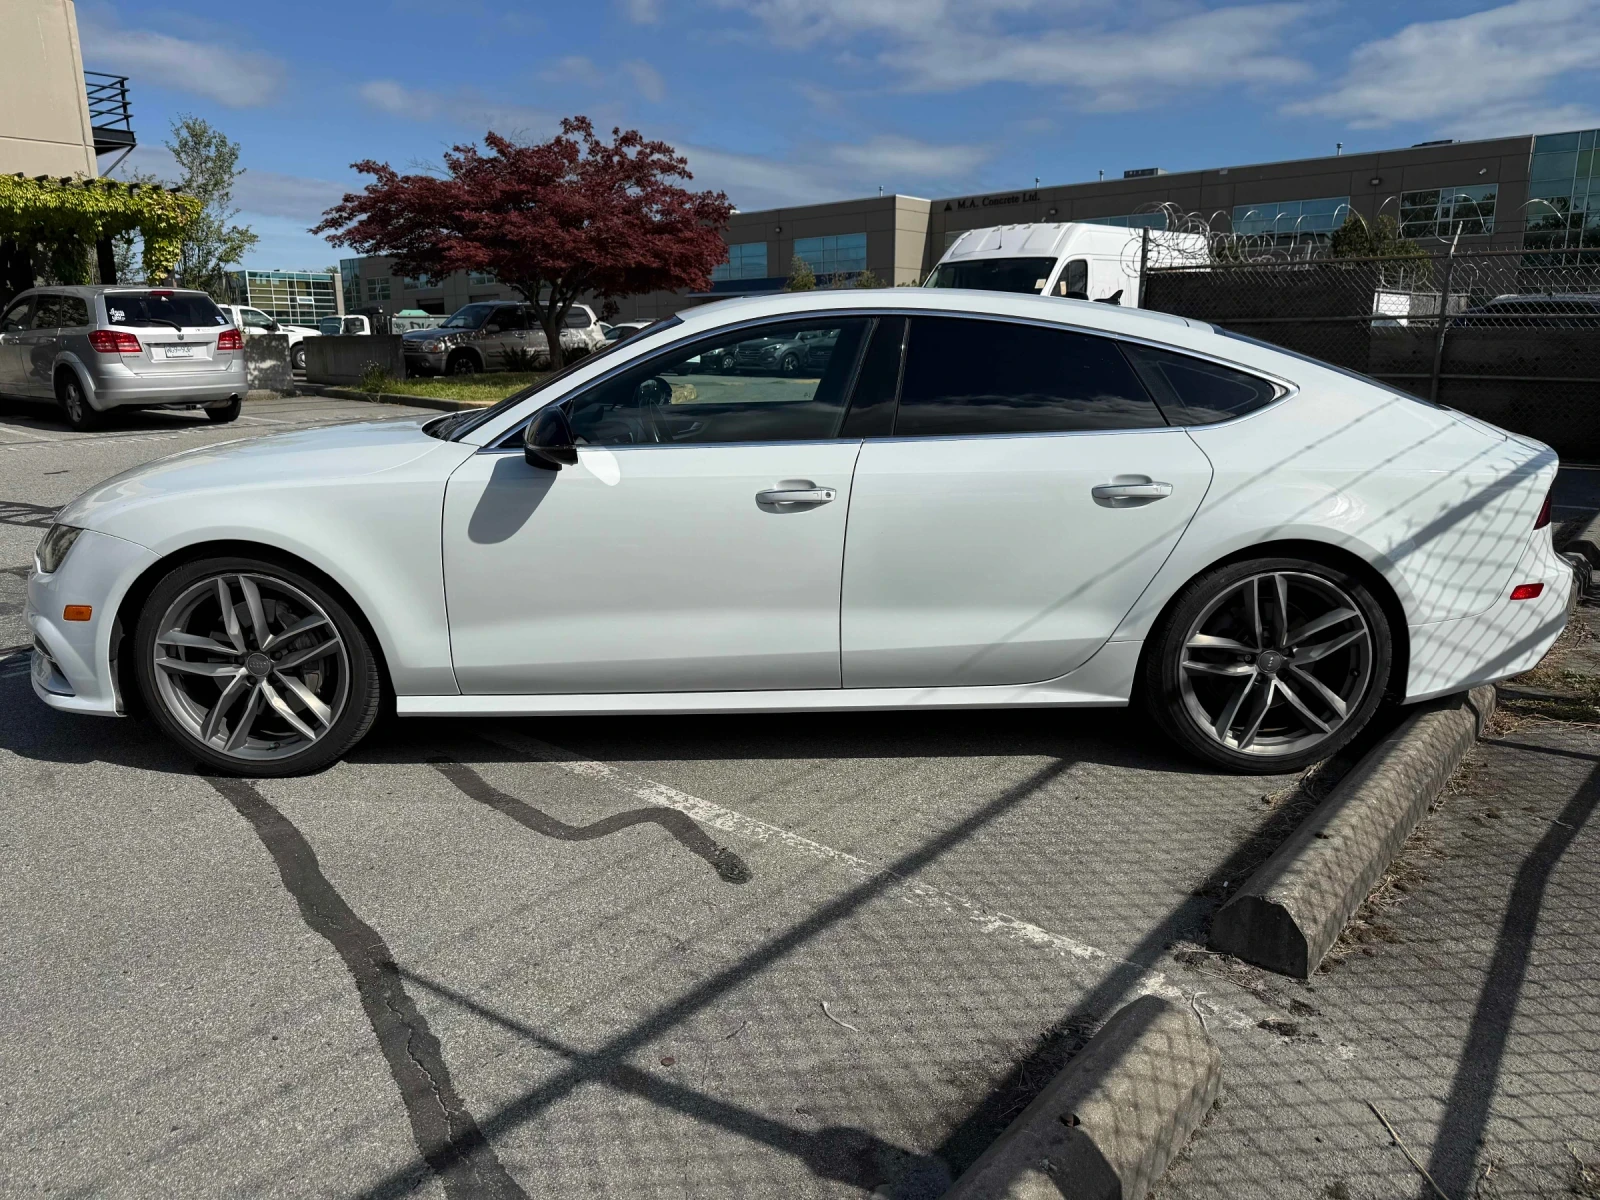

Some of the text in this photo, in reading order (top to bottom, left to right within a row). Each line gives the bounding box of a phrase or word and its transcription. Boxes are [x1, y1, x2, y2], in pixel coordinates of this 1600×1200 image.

[957, 191, 1040, 209] M.A. Concrete Ltd.
